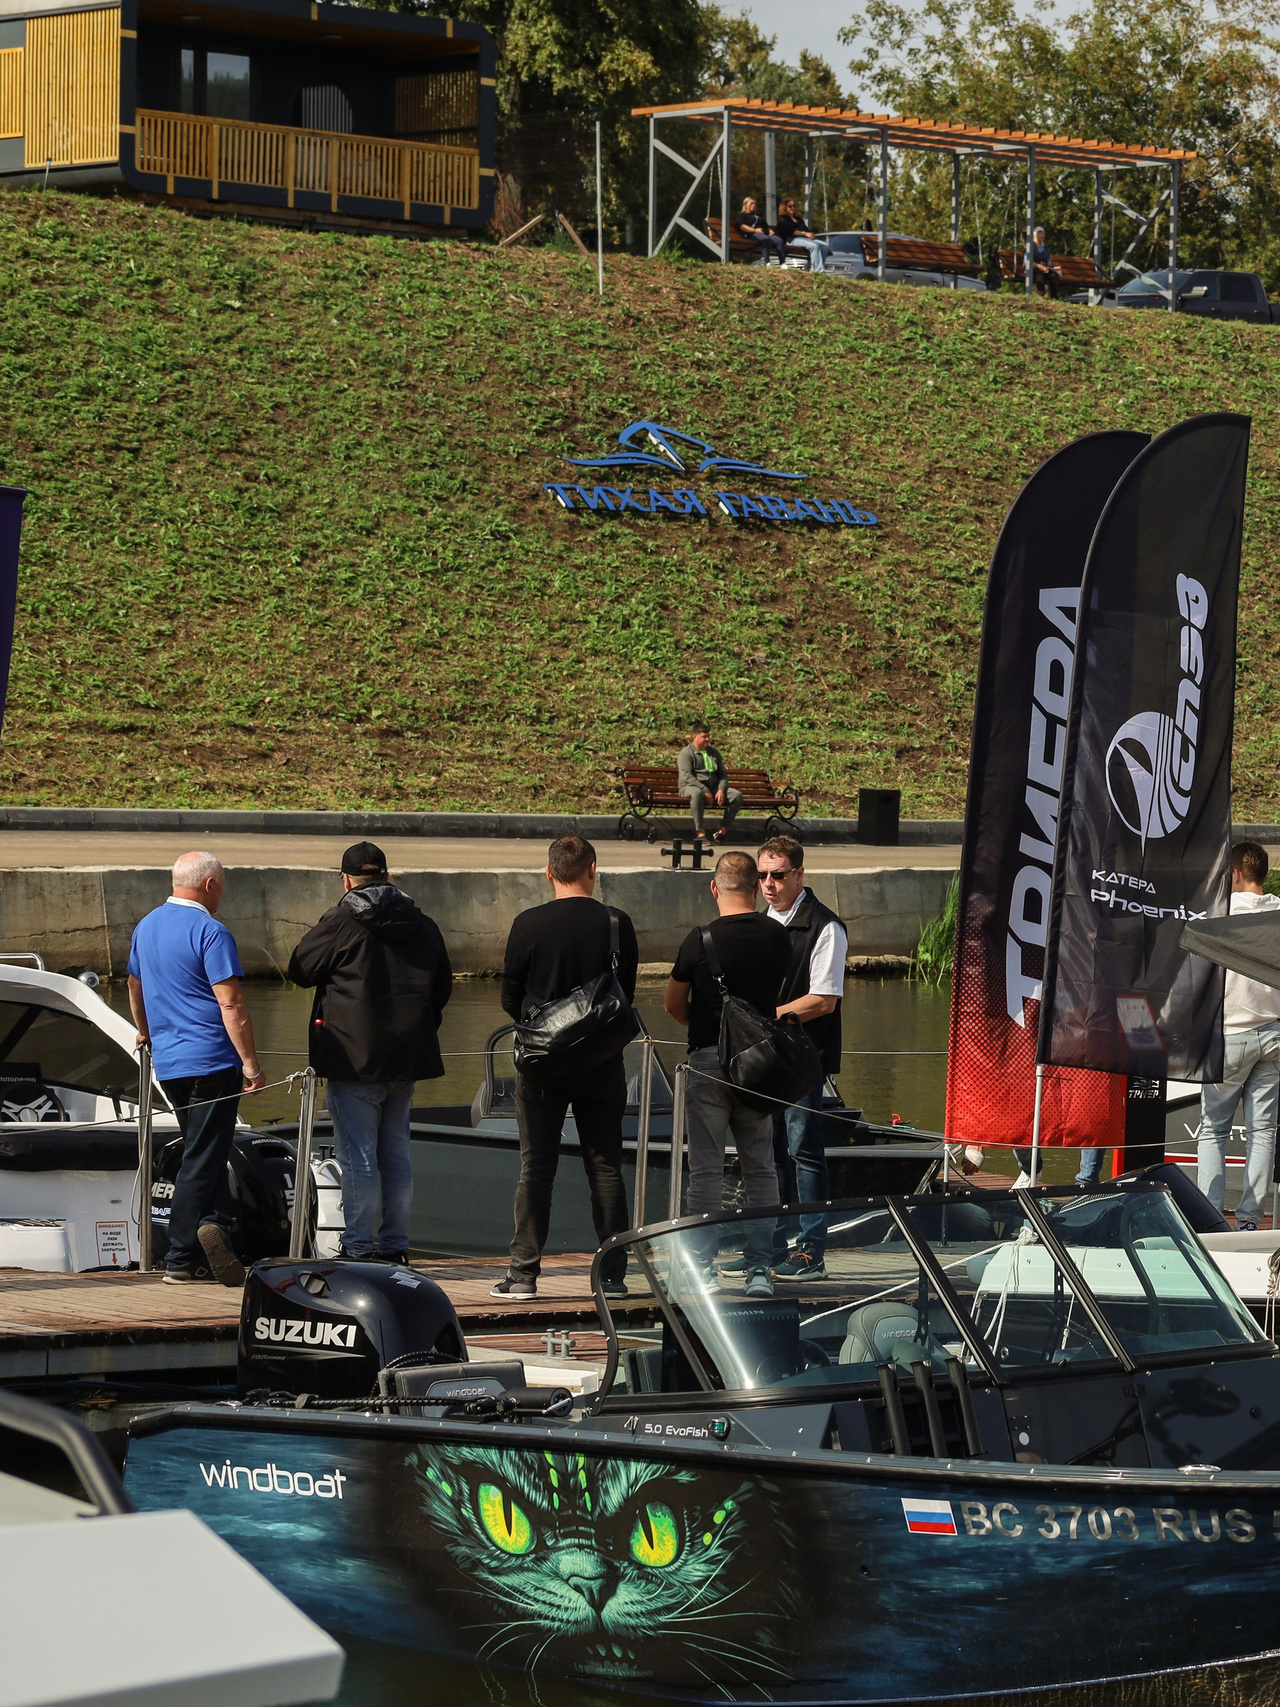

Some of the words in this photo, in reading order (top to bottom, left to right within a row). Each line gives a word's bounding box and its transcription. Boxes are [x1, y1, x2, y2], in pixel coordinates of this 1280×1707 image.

[543, 483, 707, 514] ТИХАЯ
[713, 492, 878, 525] ГАВАНЬ
[1091, 869, 1157, 894] КАТЕРА
[254, 1317, 357, 1347] SUZUKI
[881, 1329, 918, 1339] windboa
[644, 1423, 663, 1435] 5.0
[199, 1459, 347, 1499] windboat
[1035, 1504, 1140, 1541] 3703
[1152, 1506, 1257, 1544] RUS
